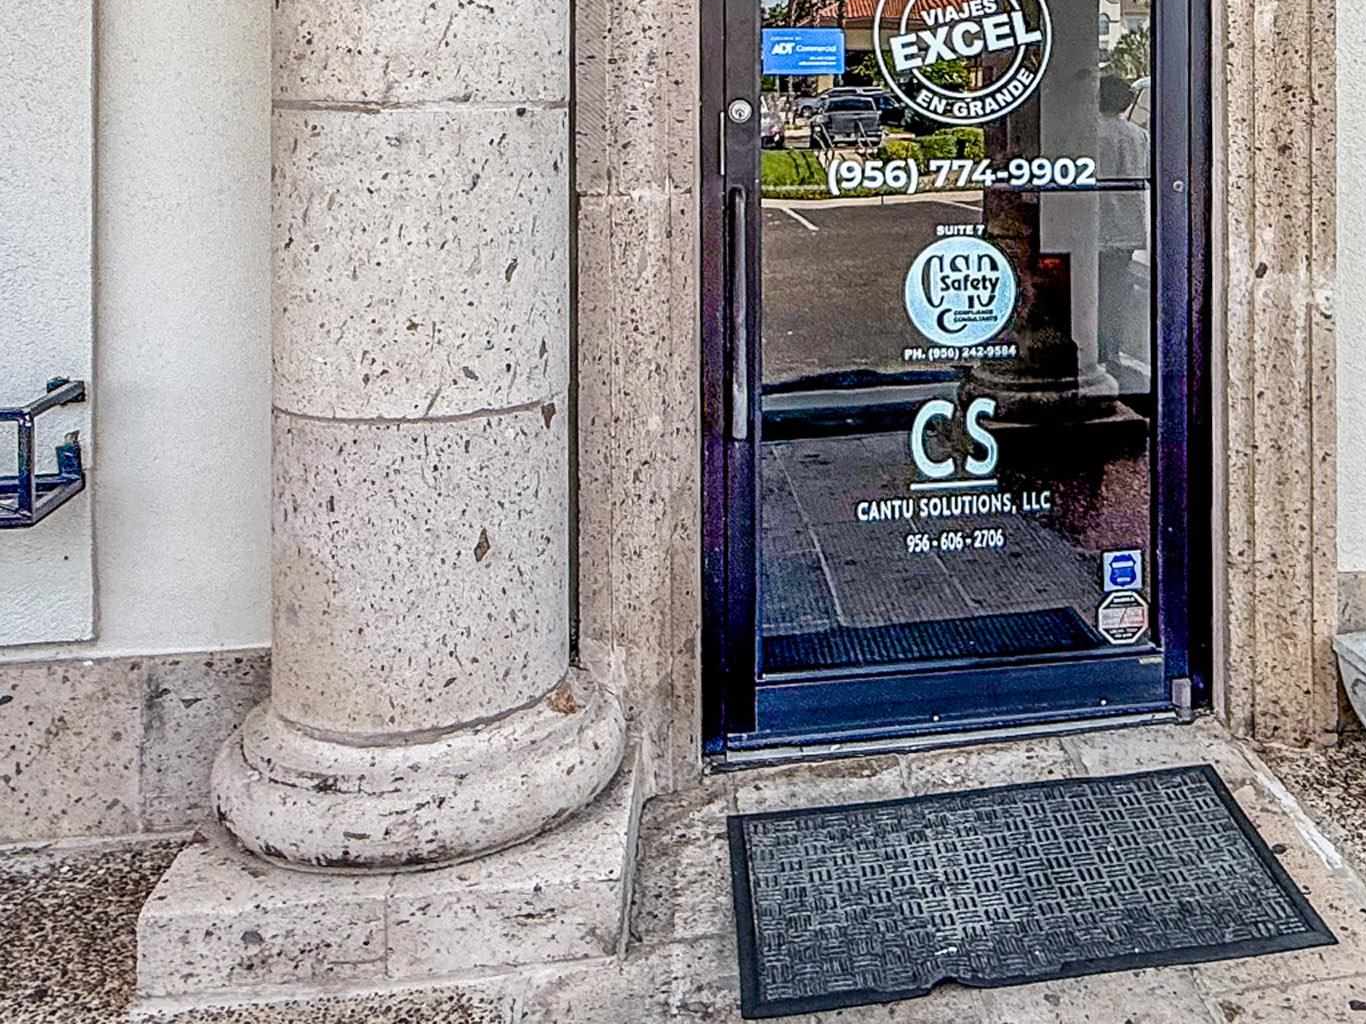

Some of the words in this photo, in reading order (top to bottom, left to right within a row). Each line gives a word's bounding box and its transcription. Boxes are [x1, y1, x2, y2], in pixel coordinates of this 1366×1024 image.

[771, 41, 796, 56] ADT
[888, 10, 1043, 72] EXCEL
[953, 66, 1035, 118] GRANDE
[827, 158, 919, 195] (956)
[928, 156, 1097, 188] 774-9902
[936, 224, 974, 236] SUITE
[975, 224, 985, 236] 7
[940, 274, 1000, 294] Safety
[910, 397, 999, 479] CS
[856, 497, 914, 522] CANTU
[918, 493, 1017, 518] SOLUTIONS,
[1022, 491, 1052, 510] LLC
